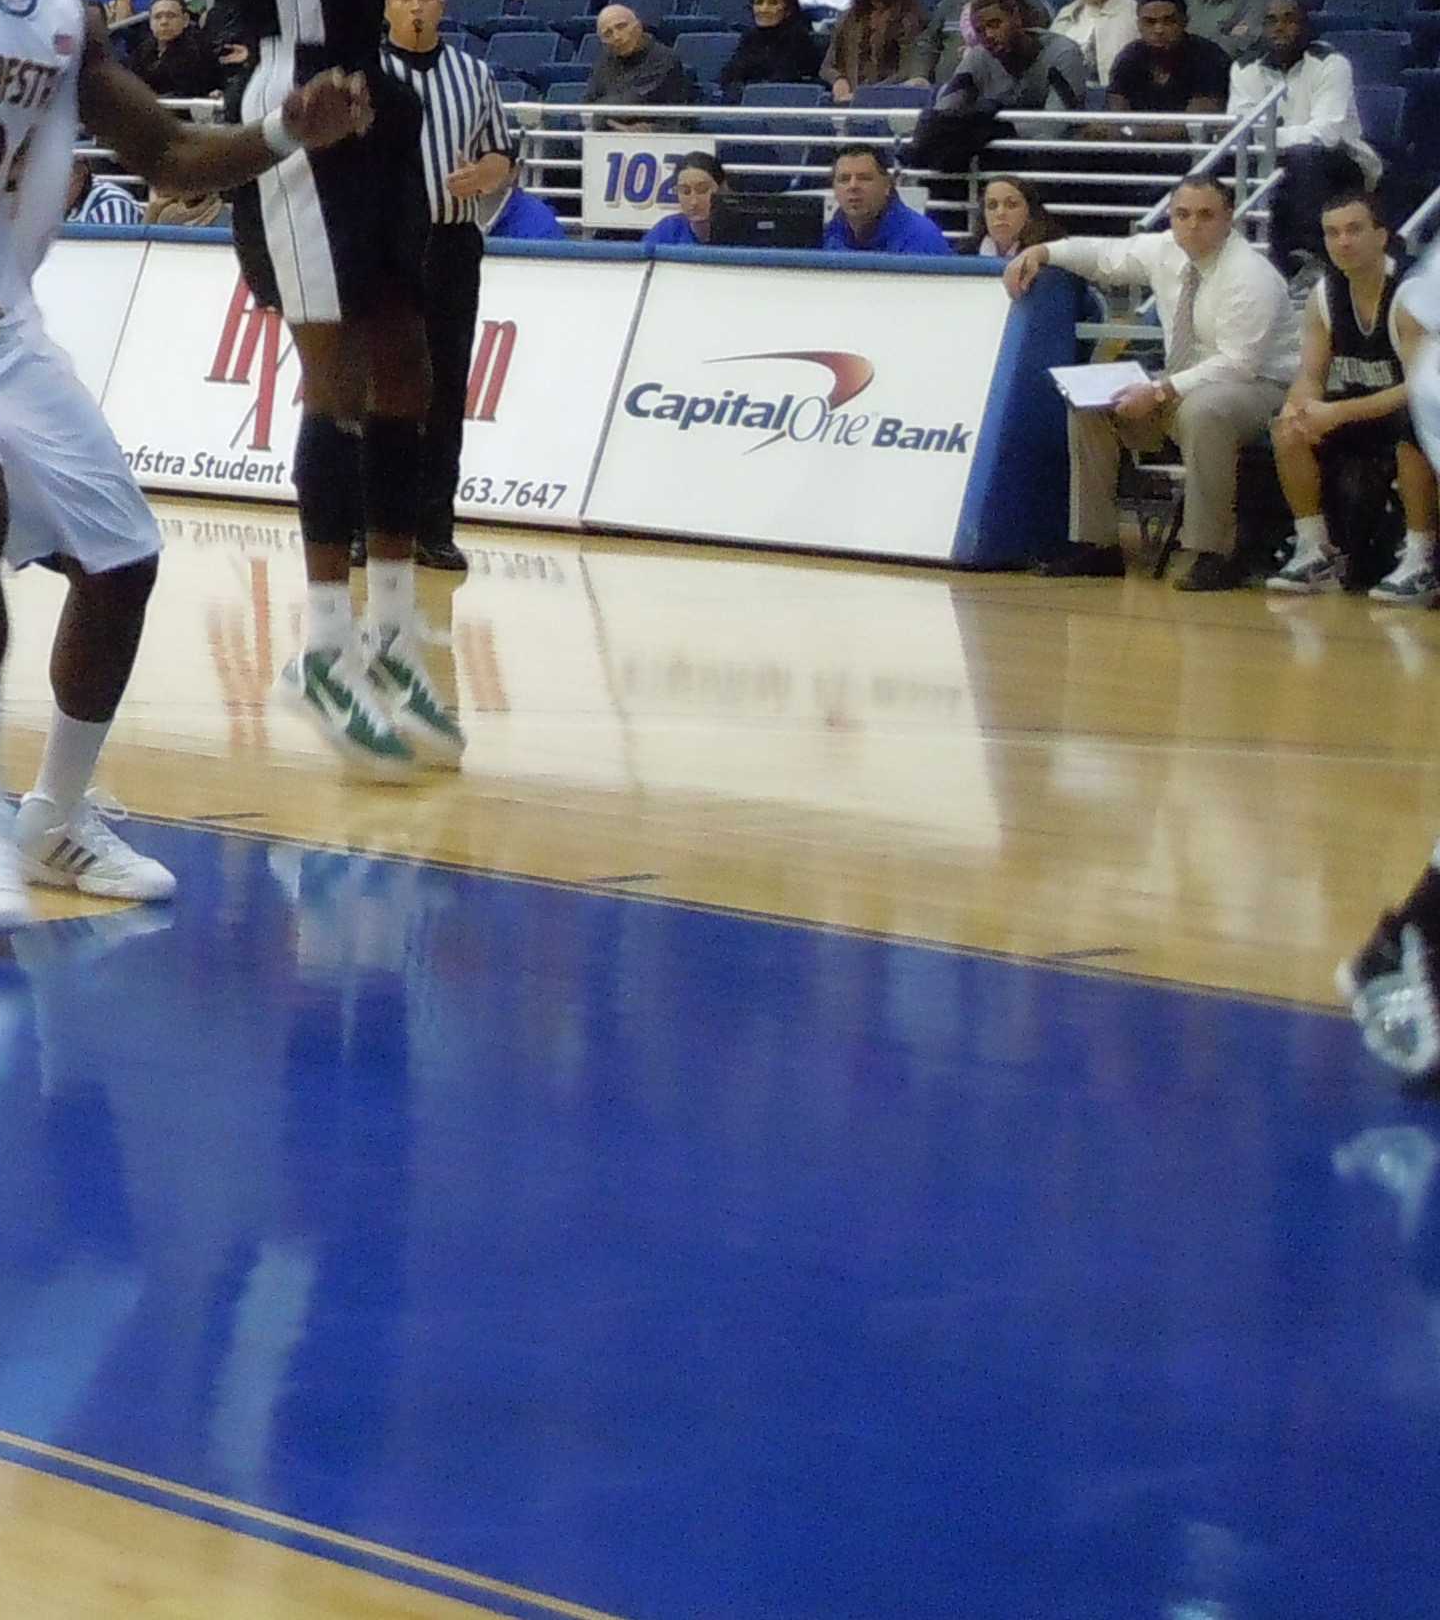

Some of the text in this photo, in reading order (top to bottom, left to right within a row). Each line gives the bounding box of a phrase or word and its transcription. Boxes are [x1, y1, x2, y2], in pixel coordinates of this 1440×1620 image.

[604, 151, 683, 204] 102
[871, 417, 972, 454] Bank
[122, 445, 568, 510] ofstra Student 63.7647
